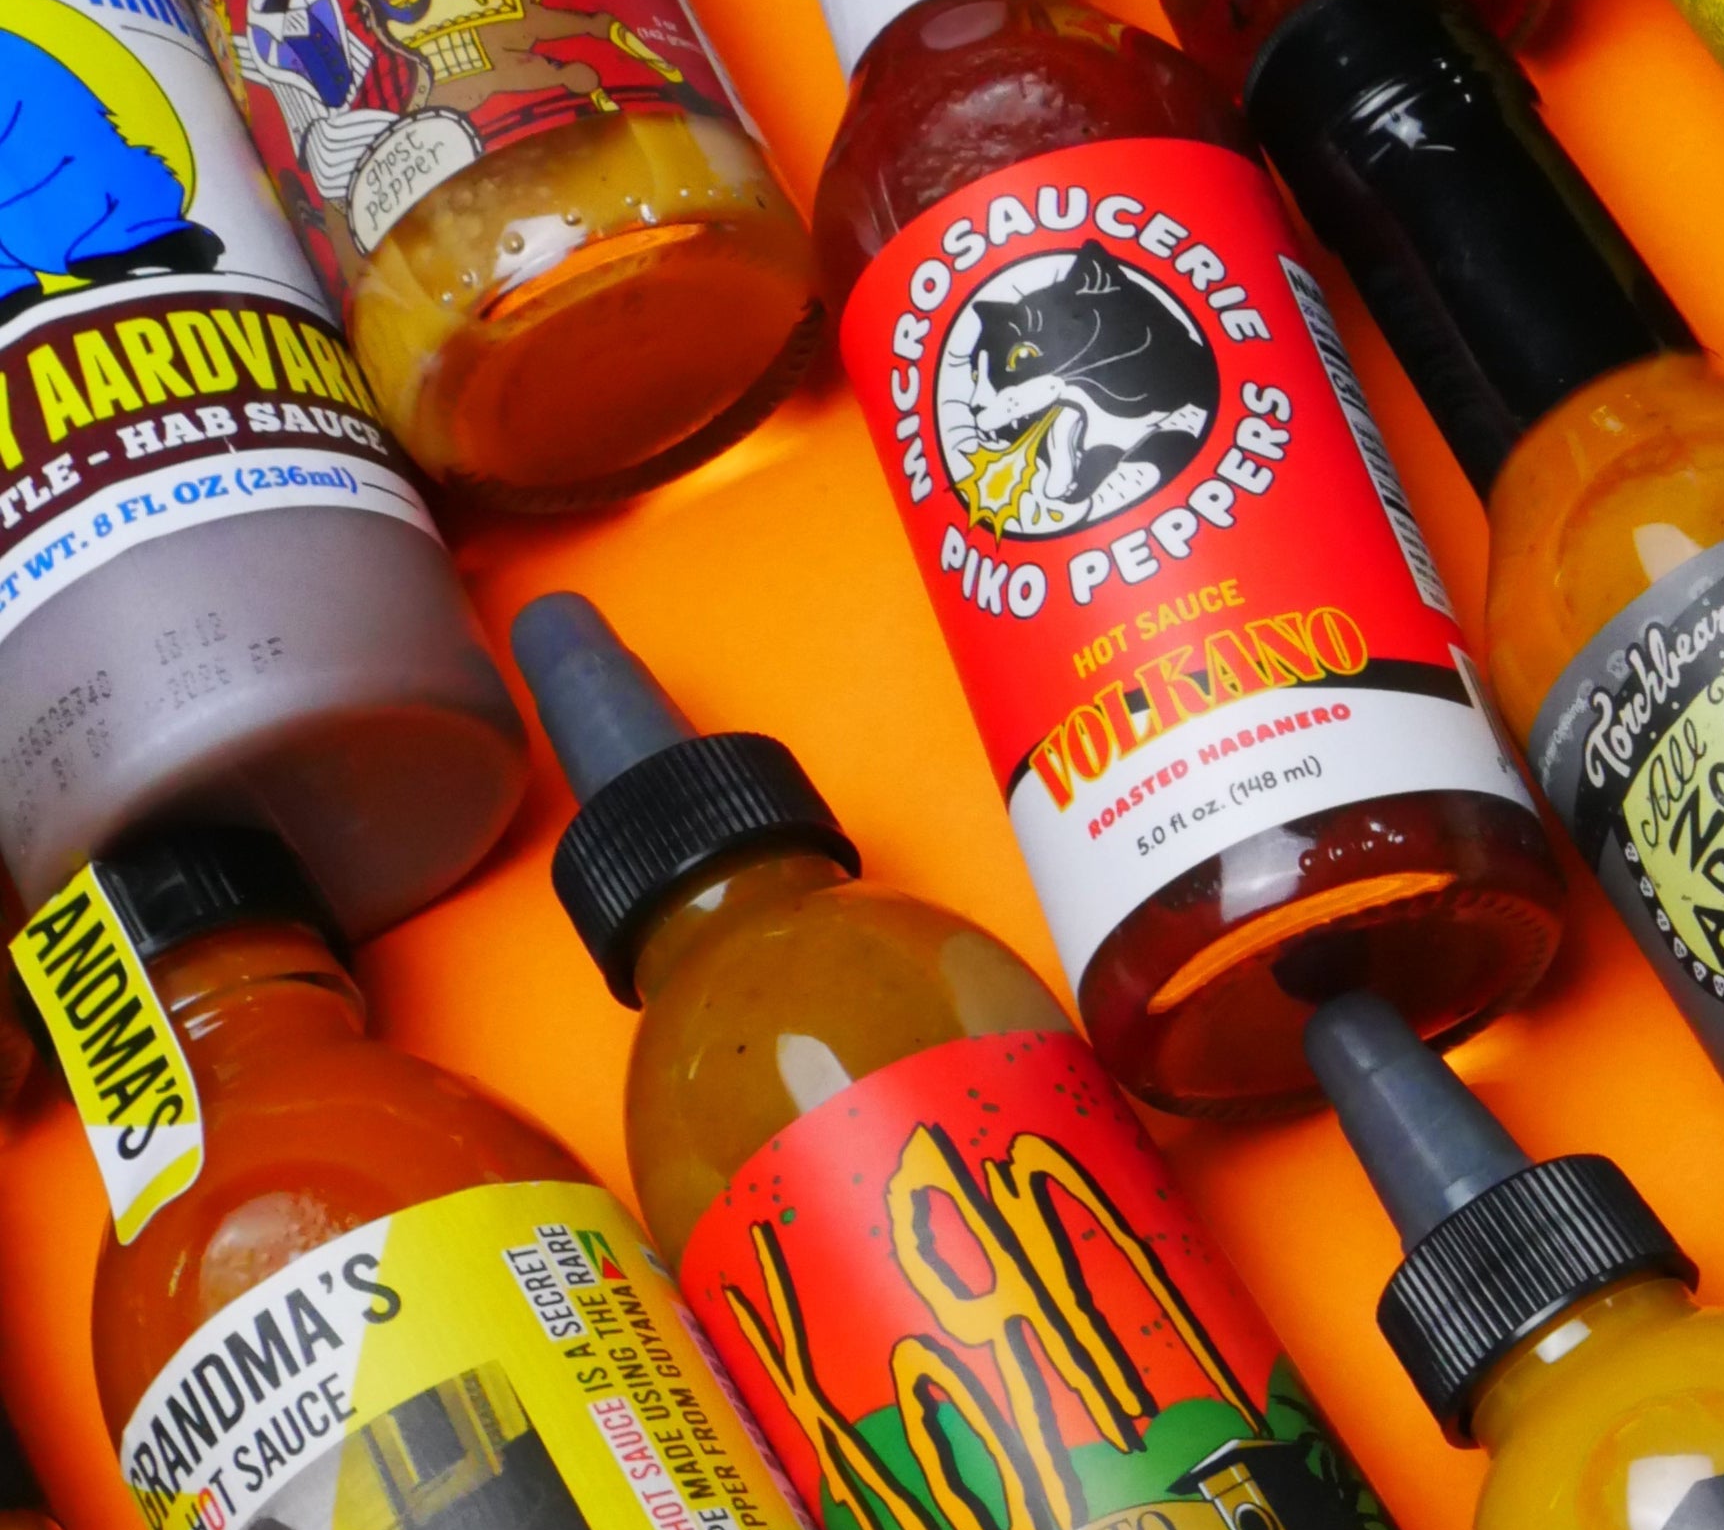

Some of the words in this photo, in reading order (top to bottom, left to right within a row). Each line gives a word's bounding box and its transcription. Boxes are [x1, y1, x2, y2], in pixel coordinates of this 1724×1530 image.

[364, 144, 444, 223] pepper
[366, 129, 425, 194] ghost
[890, 185, 1272, 503] MICROSAUCERIE
[117, 406, 238, 459] HAB
[244, 401, 389, 455] SAUCE
[23, 532, 90, 580] WT.
[92, 514, 114, 537] 8
[117, 494, 167, 524] FL
[172, 474, 228, 504] OZ
[235, 466, 358, 495] (236ml)
[940, 524, 1046, 620] PIKO
[1069, 381, 1292, 606] PEPPERS
[1073, 626, 1128, 678] HOT
[1135, 578, 1246, 642] SAUCE
[1028, 606, 1371, 811] VOLKANO
[1087, 758, 1189, 841] ROASTED
[1198, 702, 1352, 765] HABANERO
[1641, 718, 1704, 846] All
[1135, 823, 1166, 857] 5.0
[1192, 796, 1225, 822] oz.
[508, 1247, 581, 1337] SECRET
[541, 1224, 596, 1287] RARE
[576, 1365, 609, 1393] IS
[615, 1344, 672, 1422] USING
[236, 1370, 359, 1500] SAUCE
[595, 1401, 663, 1479] SAUCE
[662, 1427, 715, 1501] MADE
